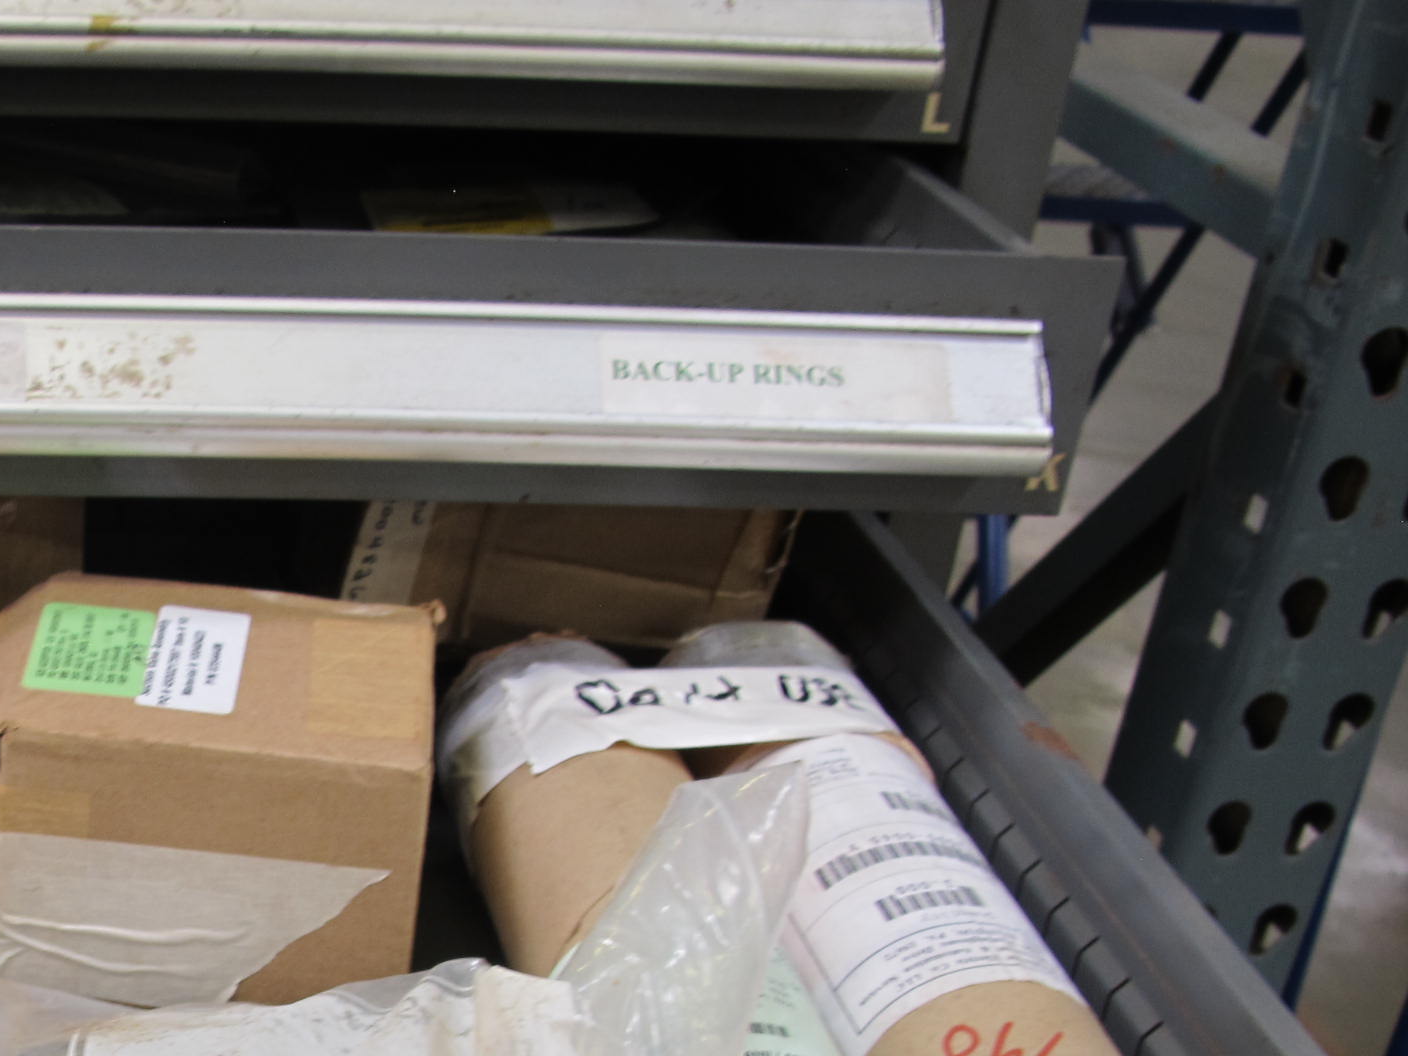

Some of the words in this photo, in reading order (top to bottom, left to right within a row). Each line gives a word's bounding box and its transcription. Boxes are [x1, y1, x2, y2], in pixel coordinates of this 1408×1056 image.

[922, 92, 951, 133] L
[612, 358, 744, 384] BACK-UP
[753, 363, 845, 387] RINGS
